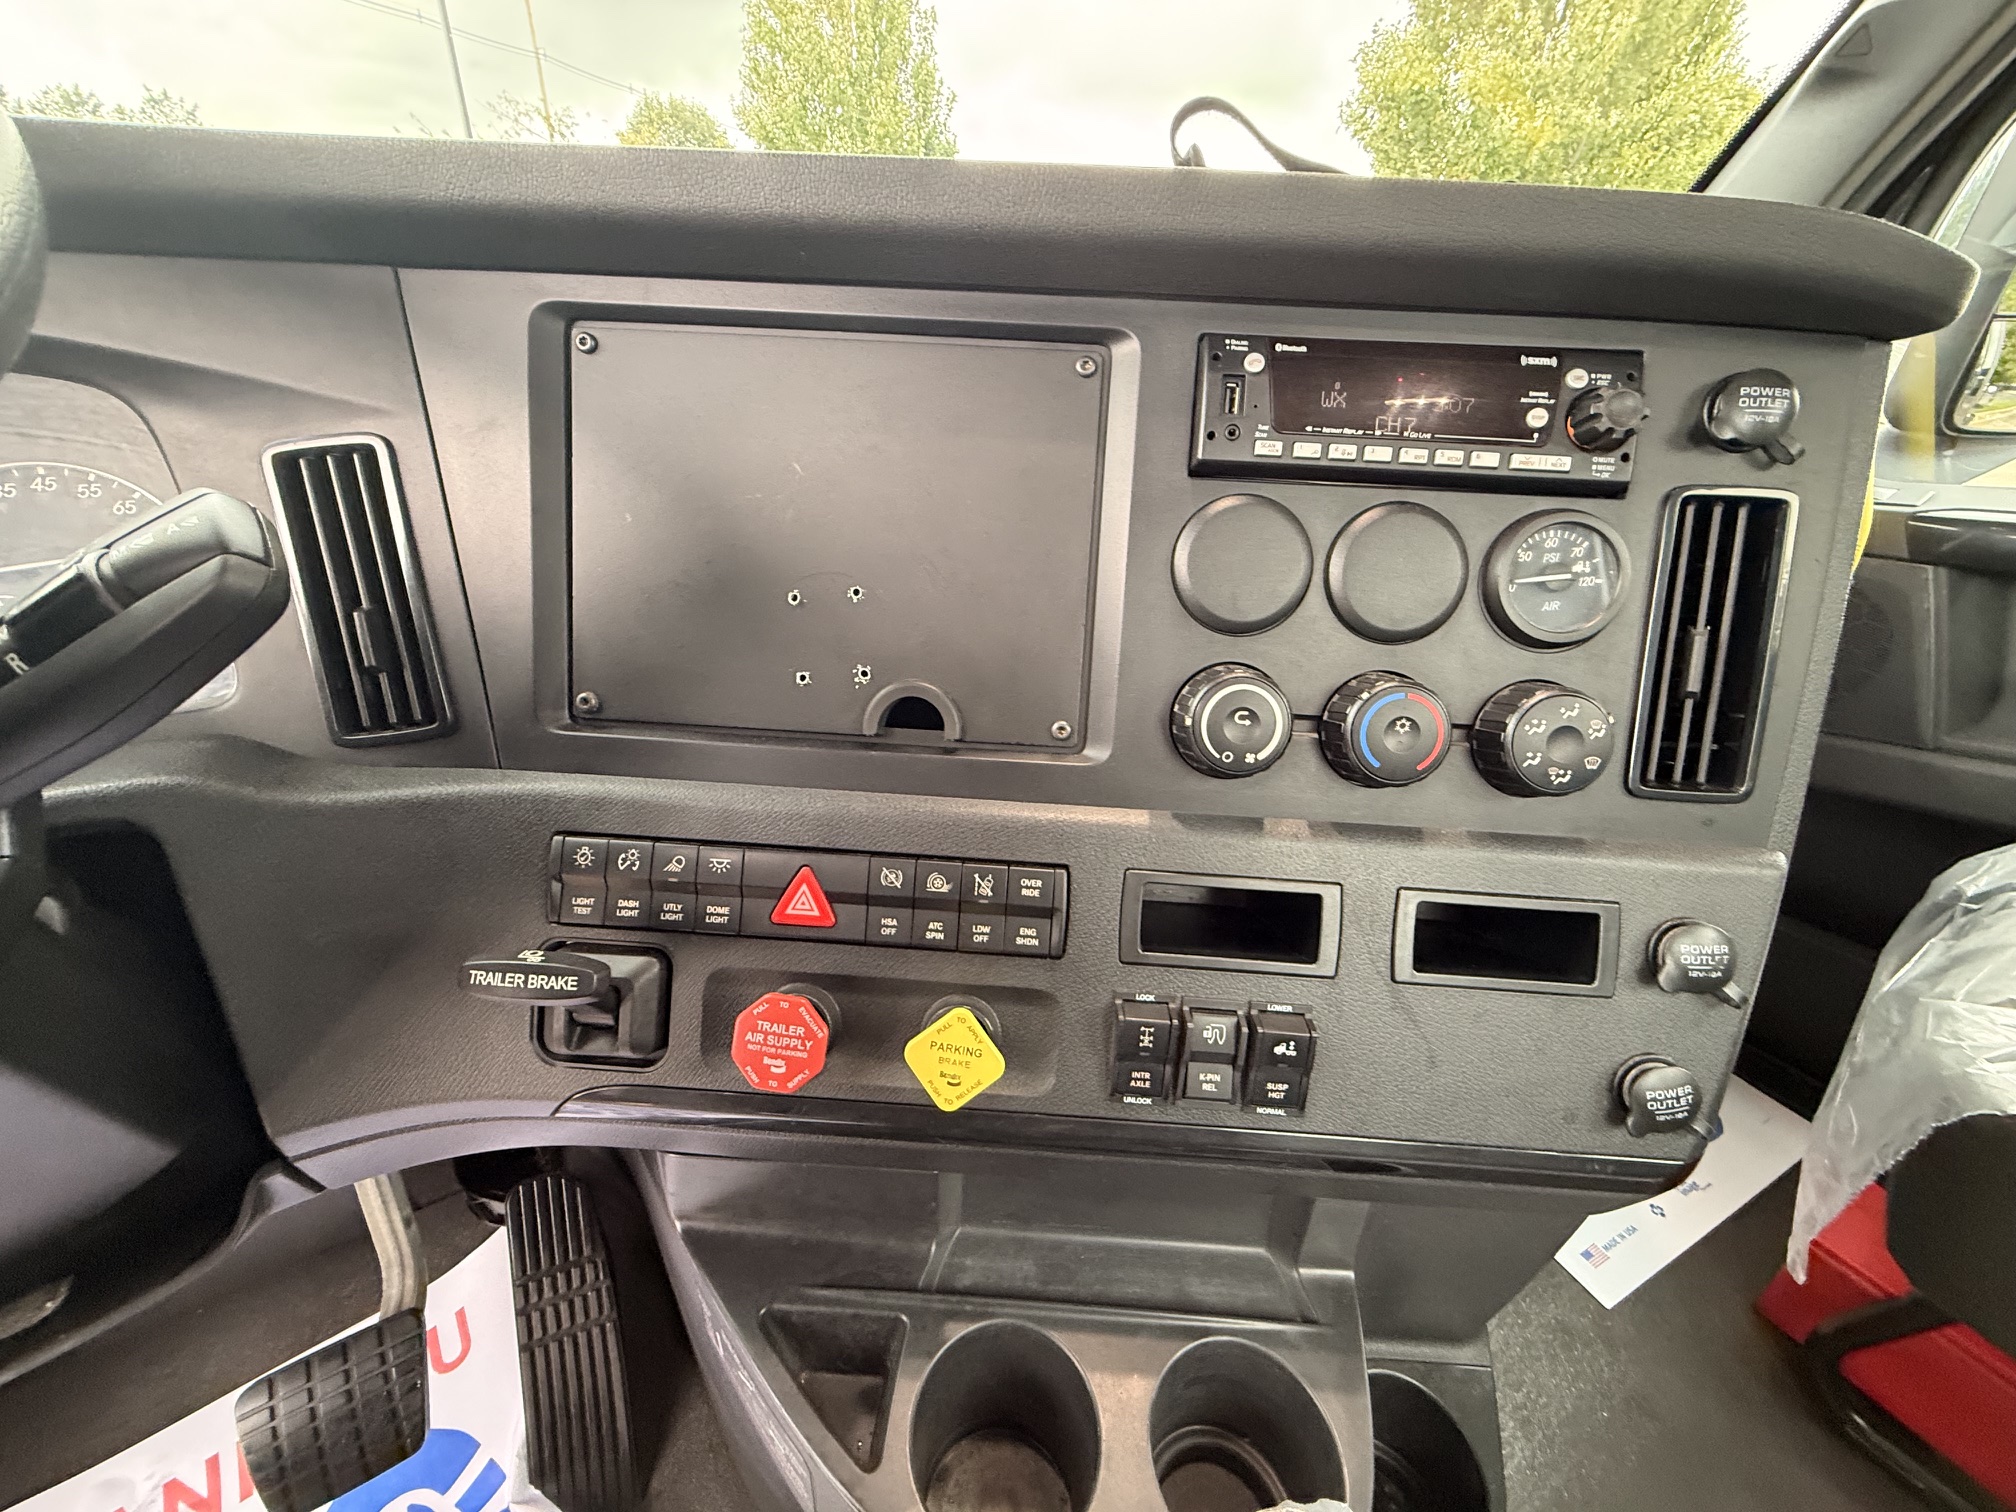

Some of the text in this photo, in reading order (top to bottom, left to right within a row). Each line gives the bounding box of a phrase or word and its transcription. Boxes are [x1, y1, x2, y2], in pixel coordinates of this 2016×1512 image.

[1740, 386, 1791, 398] POWER
[1321, 390, 1347, 408] WX
[1738, 397, 1790, 408] OUTLET
[30, 477, 57, 492] 45
[77, 484, 102, 498] 55
[112, 501, 137, 515] 65
[1544, 538, 1558, 548] 60
[1518, 551, 1532, 562] 50
[1570, 547, 1584, 557] 70
[1543, 553, 1560, 563] PSI
[1578, 576, 1595, 587] 120
[1541, 601, 1561, 611] AIR
[4, 652, 30, 675] R
[1020, 878, 1042, 888] OVER
[1021, 888, 1040, 897] RIDE
[572, 897, 595, 906] LIGHT
[617, 899, 639, 908] DASH
[663, 902, 683, 911] UTLY
[573, 906, 592, 915] TEST
[616, 908, 640, 917] LIGHT
[706, 905, 730, 914] DOME
[660, 912, 684, 921] LIGHT
[705, 915, 729, 924] LIGHT
[881, 918, 898, 926] HSA
[928, 922, 943, 930] ATC
[881, 927, 897, 936] OFF
[972, 925, 991, 933] LDW
[1019, 927, 1037, 936] ENG
[925, 931, 944, 940] SPIN
[973, 934, 989, 943] OFF
[1015, 937, 1039, 947] SHDN
[1680, 944, 1729, 955] POWER
[469, 970, 578, 991] TRAILER BRAKE
[1135, 993, 1156, 1002] LOCK
[1267, 1004, 1293, 1012] LOWER
[752, 1001, 825, 1039] PULL TO EVACUATE
[757, 1020, 806, 1037] TRAILER
[936, 1016, 984, 1044] PULL TO APPLY
[745, 1031, 813, 1050] AIR SUPPLY
[762, 1046, 776, 1054] FOR
[777, 1048, 808, 1058] PARKING
[930, 1041, 983, 1058] PARKING
[938, 1056, 971, 1069] BRAKE
[745, 1065, 760, 1083] PUSH
[787, 1069, 810, 1088] SUPPLY
[1131, 1071, 1151, 1080] INTR
[1199, 1073, 1221, 1082] K-PIN
[1130, 1080, 1151, 1088] AXLE
[1202, 1083, 1217, 1092] REL
[1266, 1082, 1289, 1091] SUSP
[927, 1080, 942, 1098] PUSH
[955, 1079, 983, 1101] RELEASE
[1268, 1091, 1285, 1099] HGT
[1646, 1085, 1694, 1100] POWER
[1123, 1096, 1152, 1105] UNLOCK
[1647, 1095, 1694, 1110] OUTLET
[1256, 1107, 1287, 1116] NORMAL
[1601, 1225, 1639, 1252] MADE IN USA
